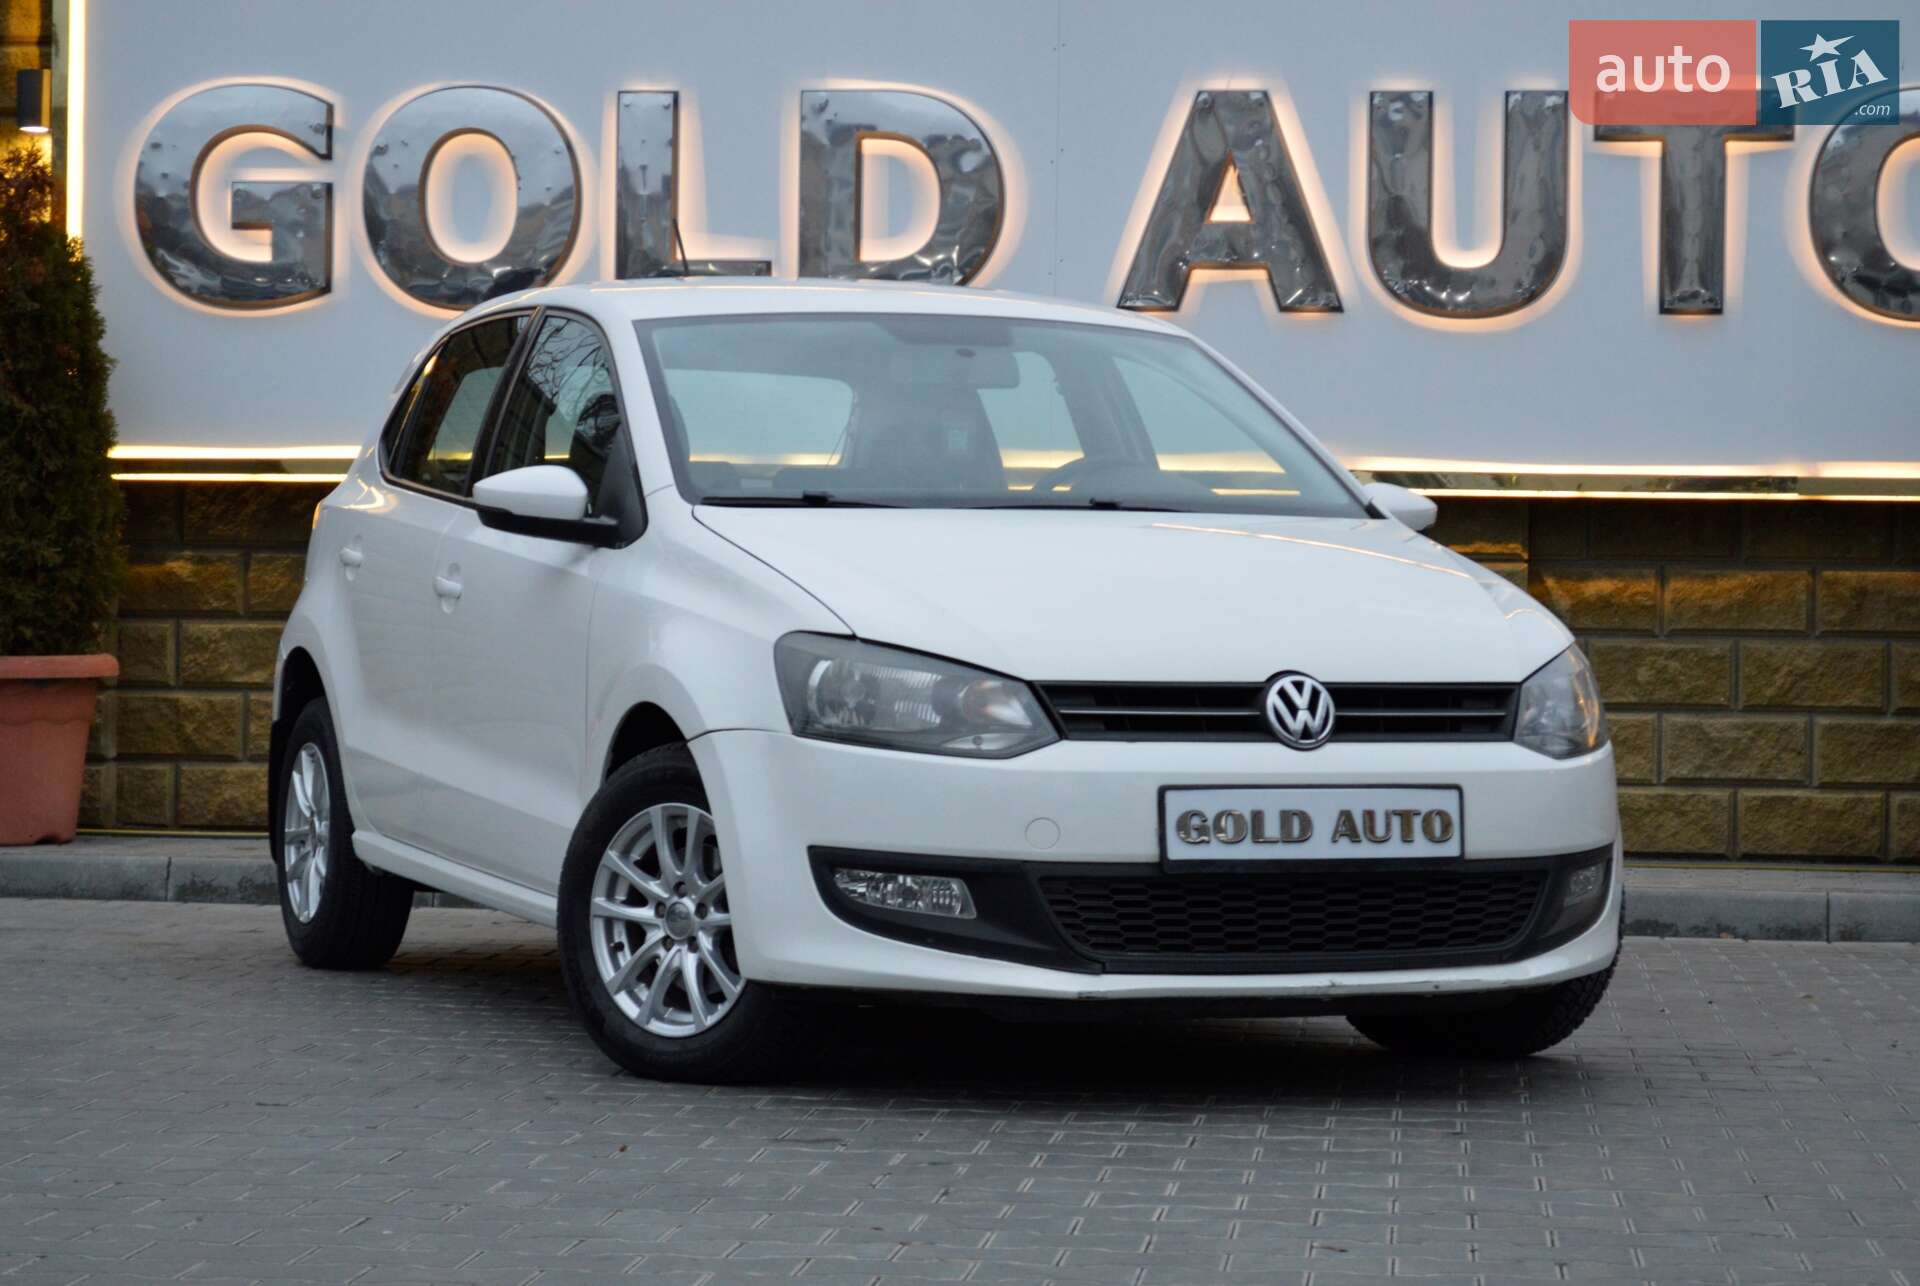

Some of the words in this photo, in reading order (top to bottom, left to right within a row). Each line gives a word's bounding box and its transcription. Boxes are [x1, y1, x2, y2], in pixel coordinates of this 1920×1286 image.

[135, 84, 1006, 311] GOLD
[1176, 809, 1313, 845] GOLD
[1331, 809, 1455, 844] AUTO
